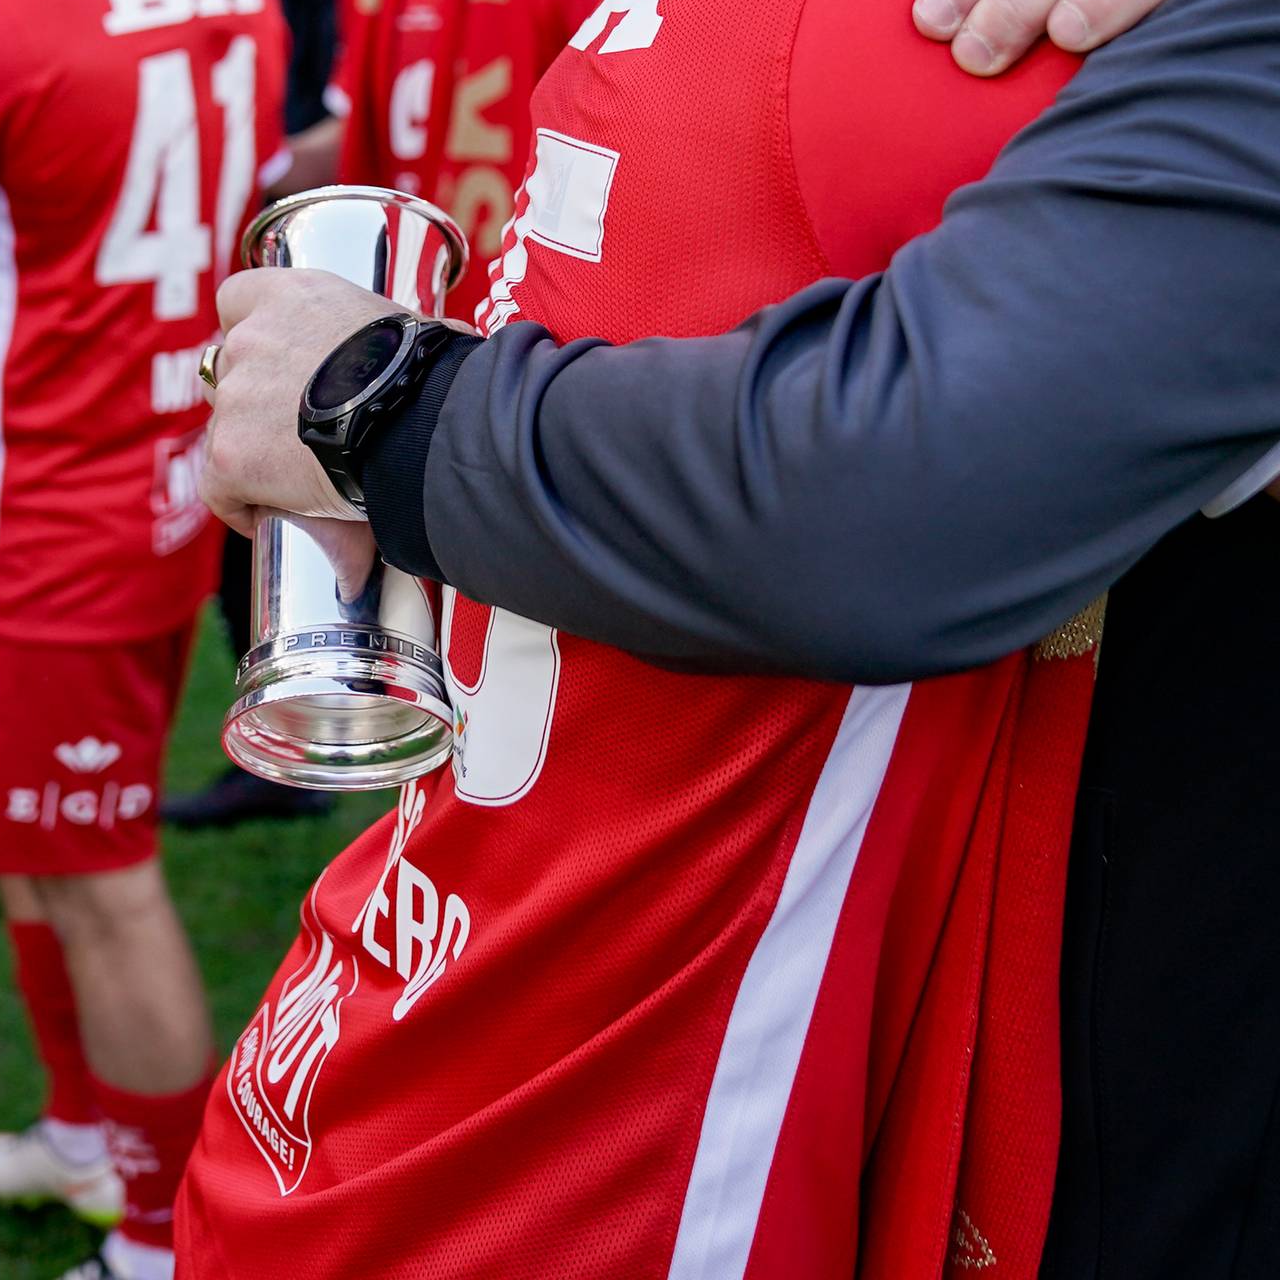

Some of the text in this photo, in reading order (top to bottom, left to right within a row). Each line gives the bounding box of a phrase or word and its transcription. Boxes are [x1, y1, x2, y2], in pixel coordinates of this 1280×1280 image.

[95, 36, 257, 319] 41
[283, 631, 426, 663] PREMIE
[236, 1071, 296, 1172] COURAGE!
